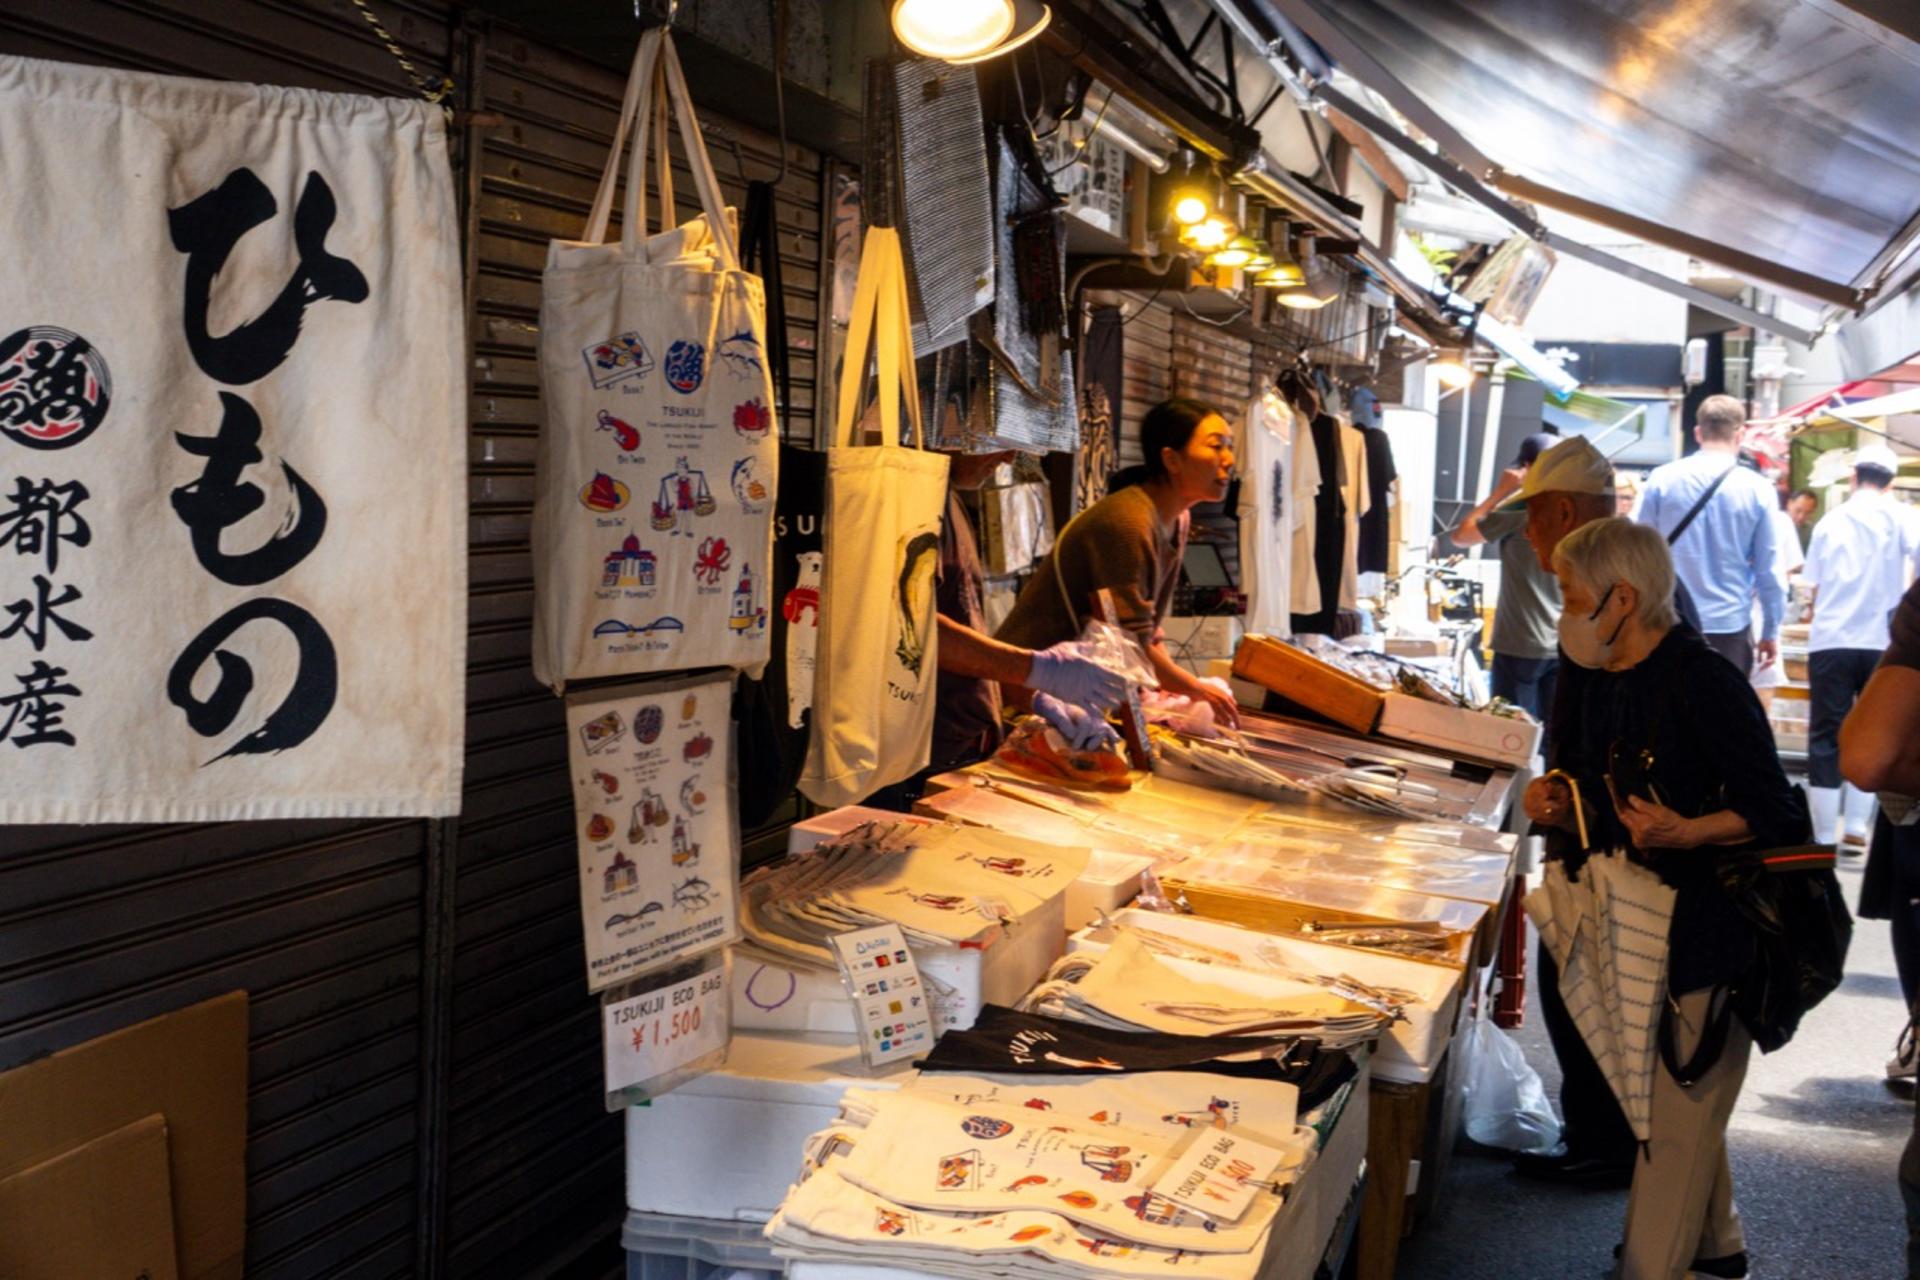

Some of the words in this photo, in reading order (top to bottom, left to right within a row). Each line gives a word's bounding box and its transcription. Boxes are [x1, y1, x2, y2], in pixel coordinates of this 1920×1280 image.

[168, 166, 369, 767] ひもの
[0, 476, 95, 748] 都水産
[612, 996, 665, 1026] TSUKIJI
[673, 986, 694, 1007] ECO
[701, 975, 722, 997] BAG
[1173, 1169, 1208, 1199] TSUKIJI
[1199, 1153, 1220, 1170] ECO
[1212, 1136, 1235, 1154] BAG
